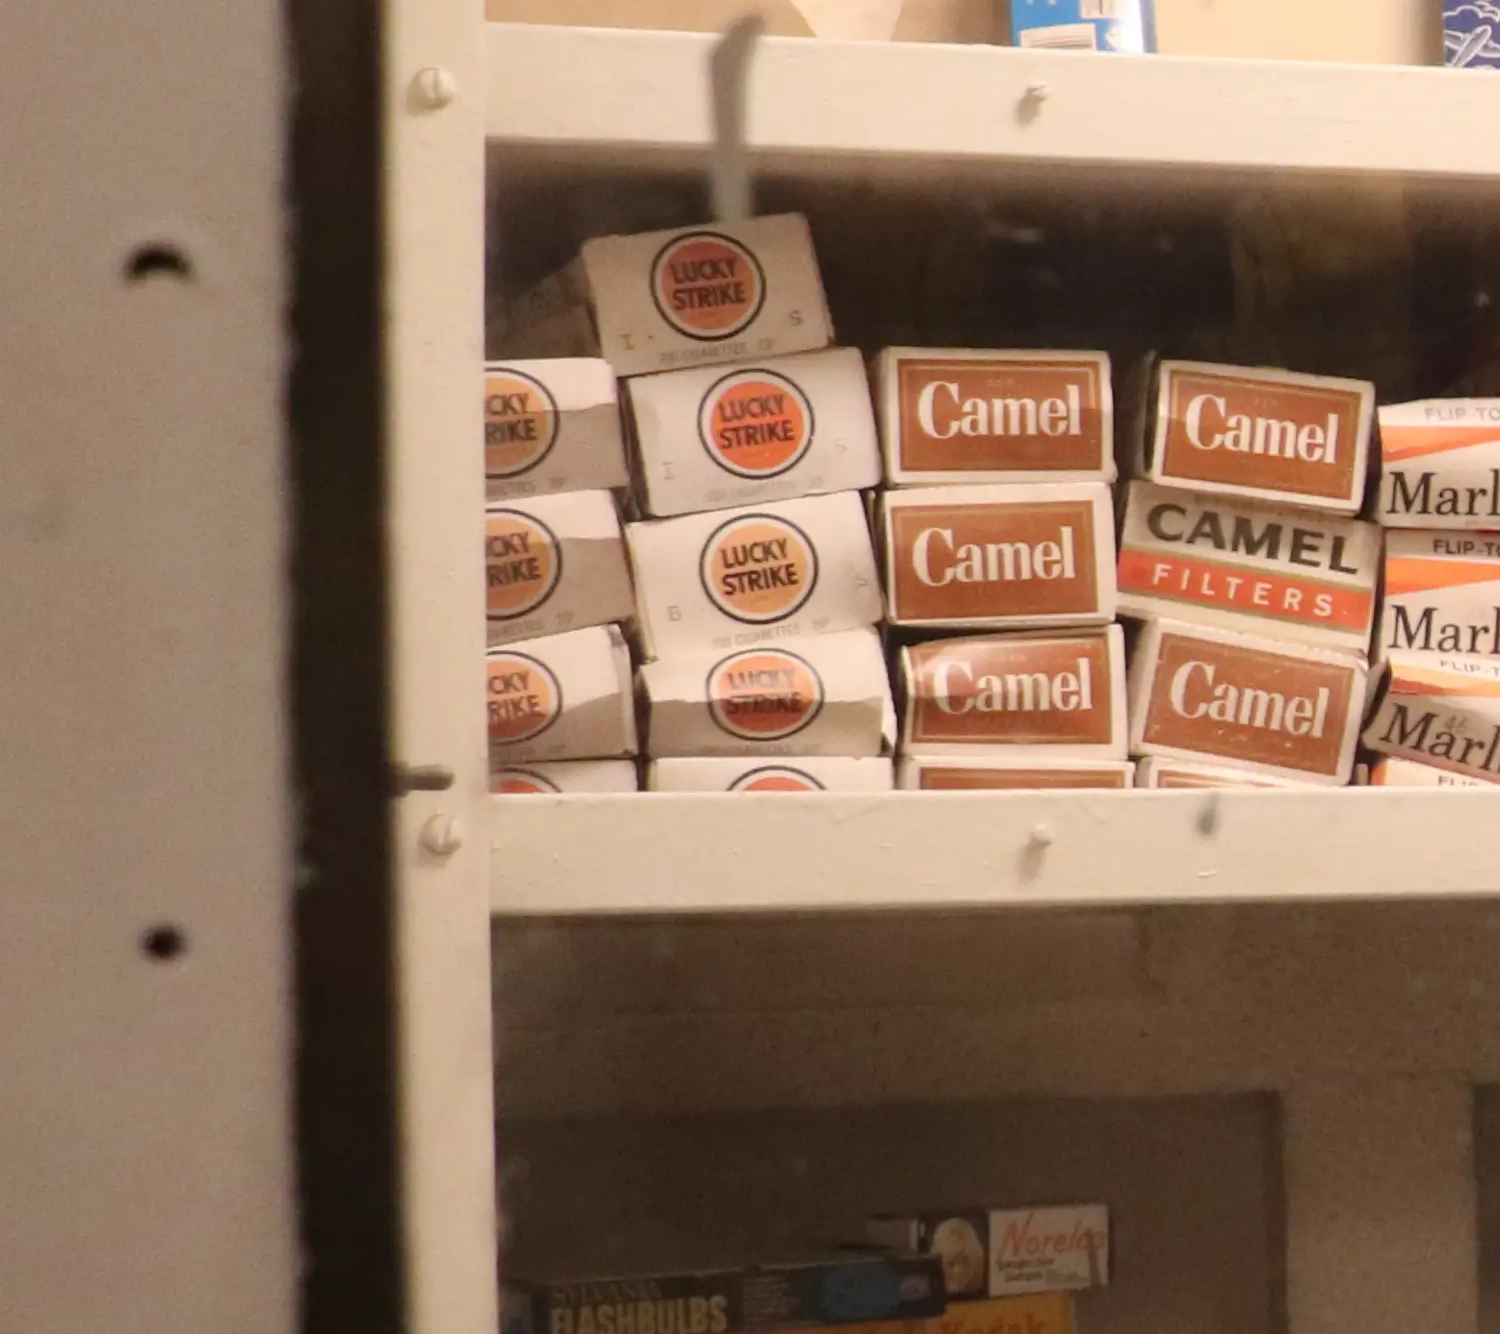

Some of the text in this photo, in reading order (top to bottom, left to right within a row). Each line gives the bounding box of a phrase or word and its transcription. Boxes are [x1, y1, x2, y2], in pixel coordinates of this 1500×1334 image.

[670, 257, 736, 283] LUCKY
[671, 282, 748, 311] STRIKE
[488, 394, 530, 416] CKY
[719, 395, 786, 420] LUCKY
[917, 380, 1082, 440] Camel
[719, 421, 795, 449] STRIKE
[1185, 392, 1338, 464] Camel
[486, 532, 531, 556] CKY
[1145, 501, 1359, 576] CAMEL
[720, 540, 788, 566] LUCKY
[911, 524, 1076, 587] Camel
[722, 566, 799, 595] STRIKE
[1152, 562, 1335, 618] FILTERS
[488, 672, 530, 696] CKY
[726, 666, 797, 690] LUCKY
[932, 655, 1093, 715] Camel
[725, 691, 802, 718] STRIKE
[1169, 659, 1330, 739] Camel
